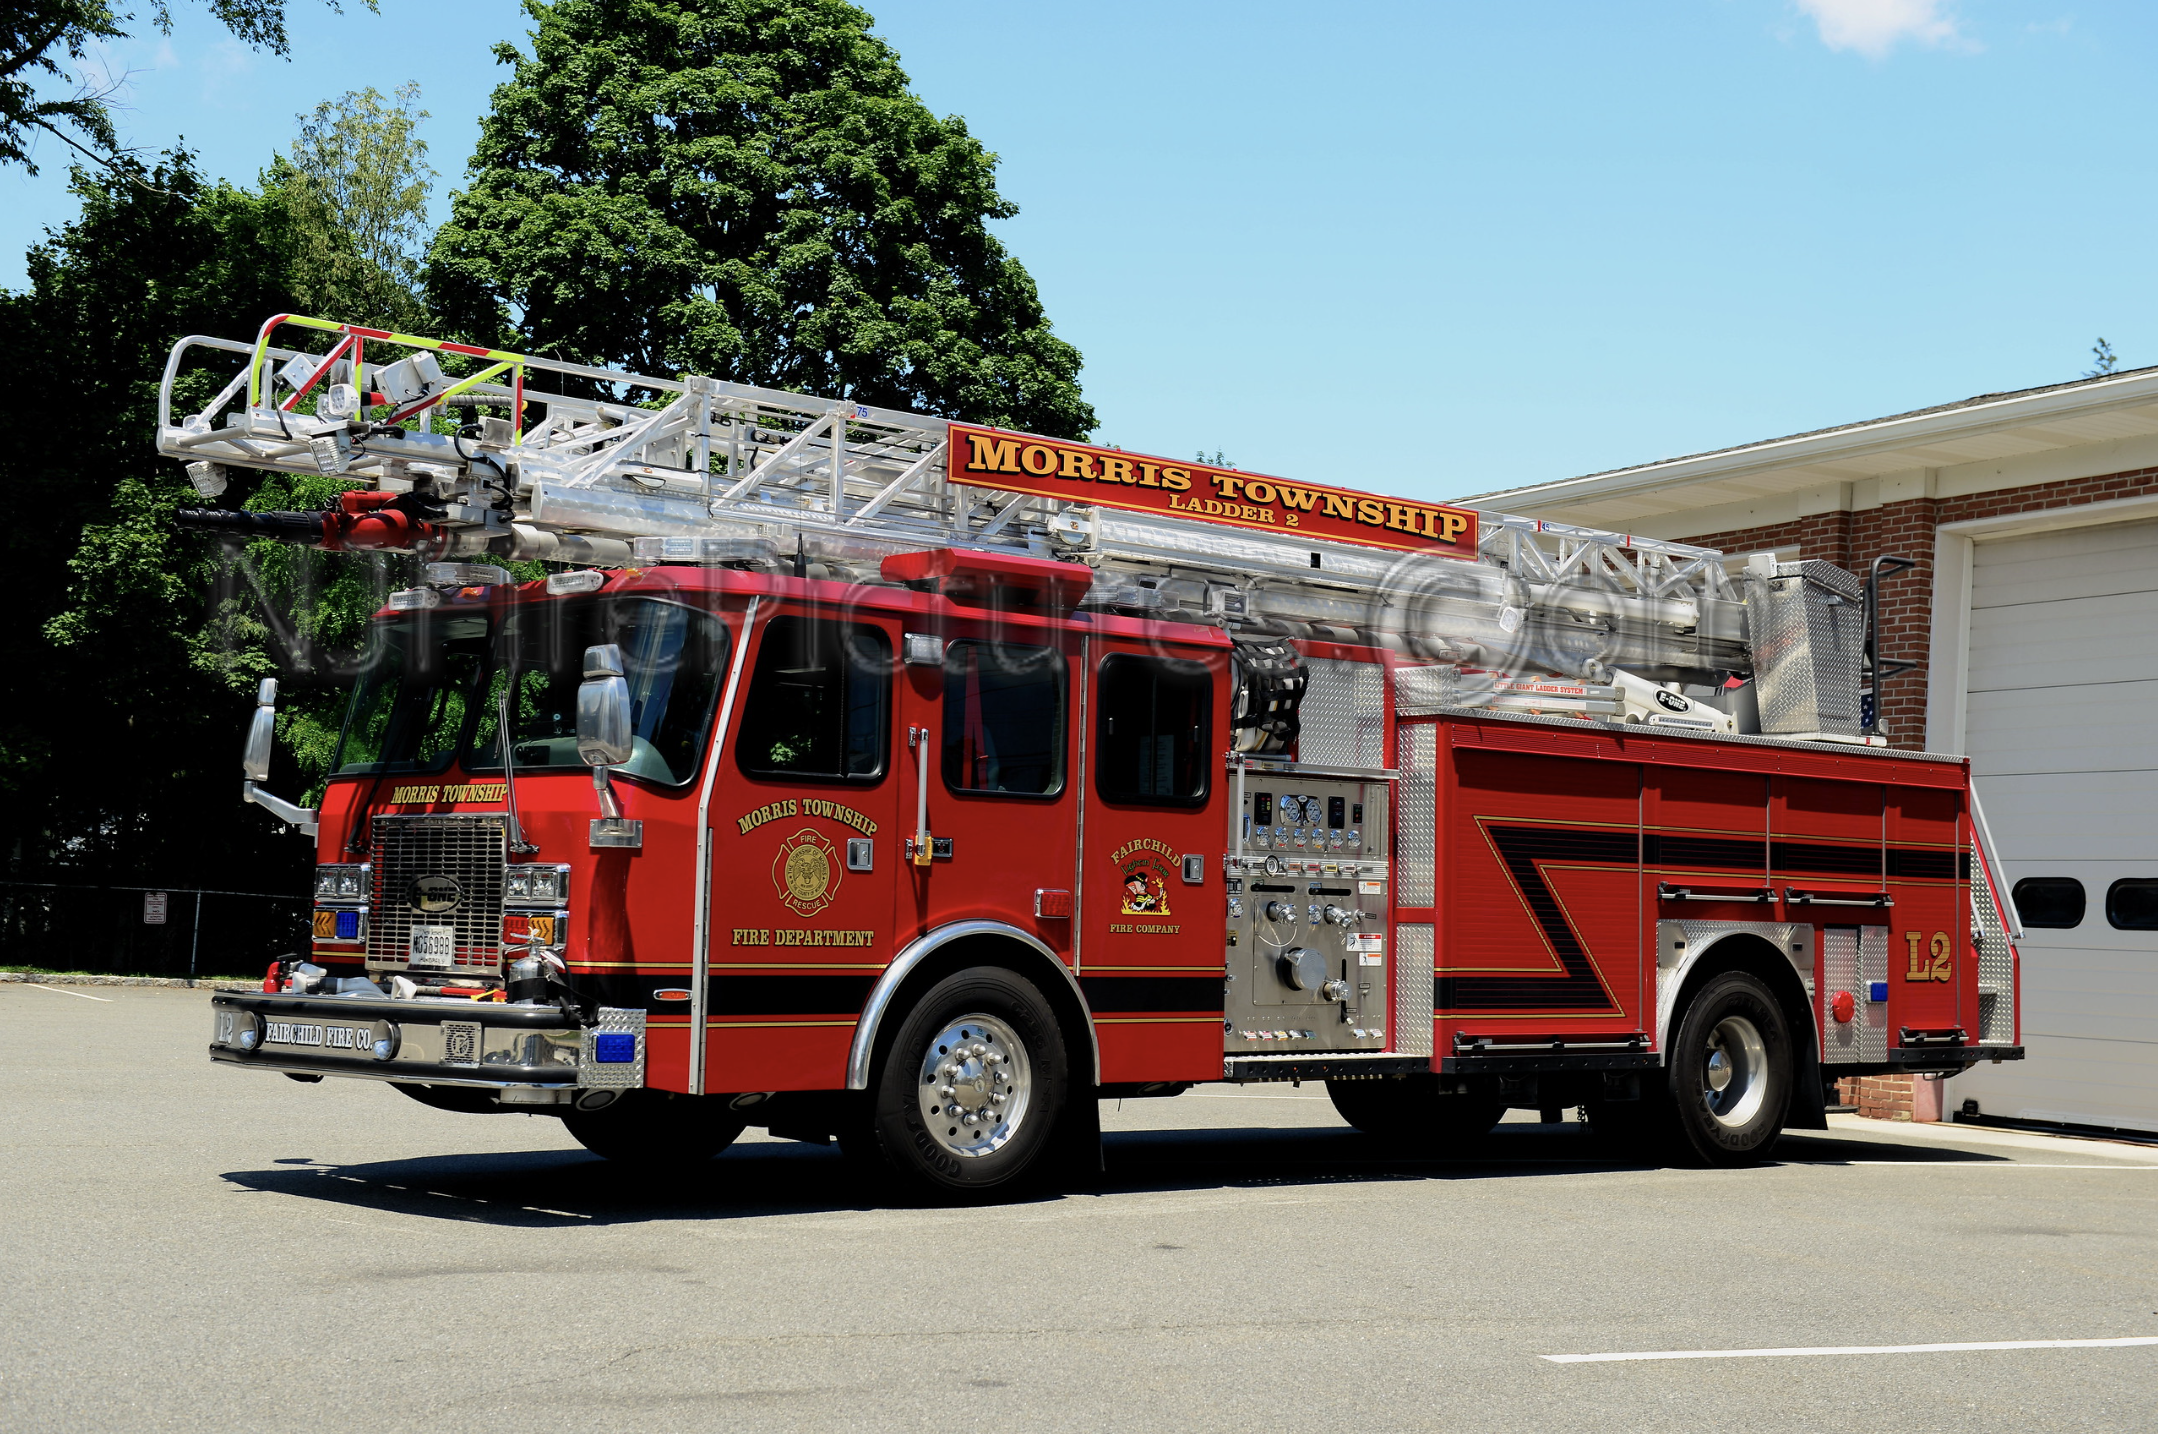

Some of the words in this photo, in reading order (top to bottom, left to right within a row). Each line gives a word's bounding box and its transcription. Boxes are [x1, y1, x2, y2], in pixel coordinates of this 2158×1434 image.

[856, 406, 868, 418] 75
[966, 434, 1192, 493] MORRIS
[1210, 474, 1469, 545] TOWNSHIP
[1169, 493, 1277, 524] LADDER
[1285, 513, 1300, 527] 2
[1541, 522, 1550, 532] 45
[1494, 681, 1514, 690] LITTLE
[1516, 683, 1535, 691] GIANT
[1535, 684, 1559, 693] LADDER
[1559, 686, 1584, 695] SYSTEM
[1659, 692, 1686, 711] E-ONE
[390, 785, 440, 804] MORRIS
[441, 783, 508, 804] TOWNSHIP
[736, 798, 798, 836] MORRIS
[802, 798, 879, 838] TOWNSHIP
[800, 835, 817, 844] FIRE
[1110, 838, 1182, 868] FAIRCHILD
[412, 886, 457, 903] E-ONE
[793, 899, 822, 909] RESCUE
[732, 928, 770, 946] FIRE
[774, 928, 875, 947] DEPARTMENT
[1109, 924, 1133, 934] FIRE
[1135, 924, 1181, 935] COMPANY
[1905, 931, 1952, 983] L2
[218, 1011, 234, 1045] L2
[265, 1021, 323, 1047] FAIRCHILD
[325, 1026, 354, 1049] FIRE
[356, 1028, 374, 1051] CO.
